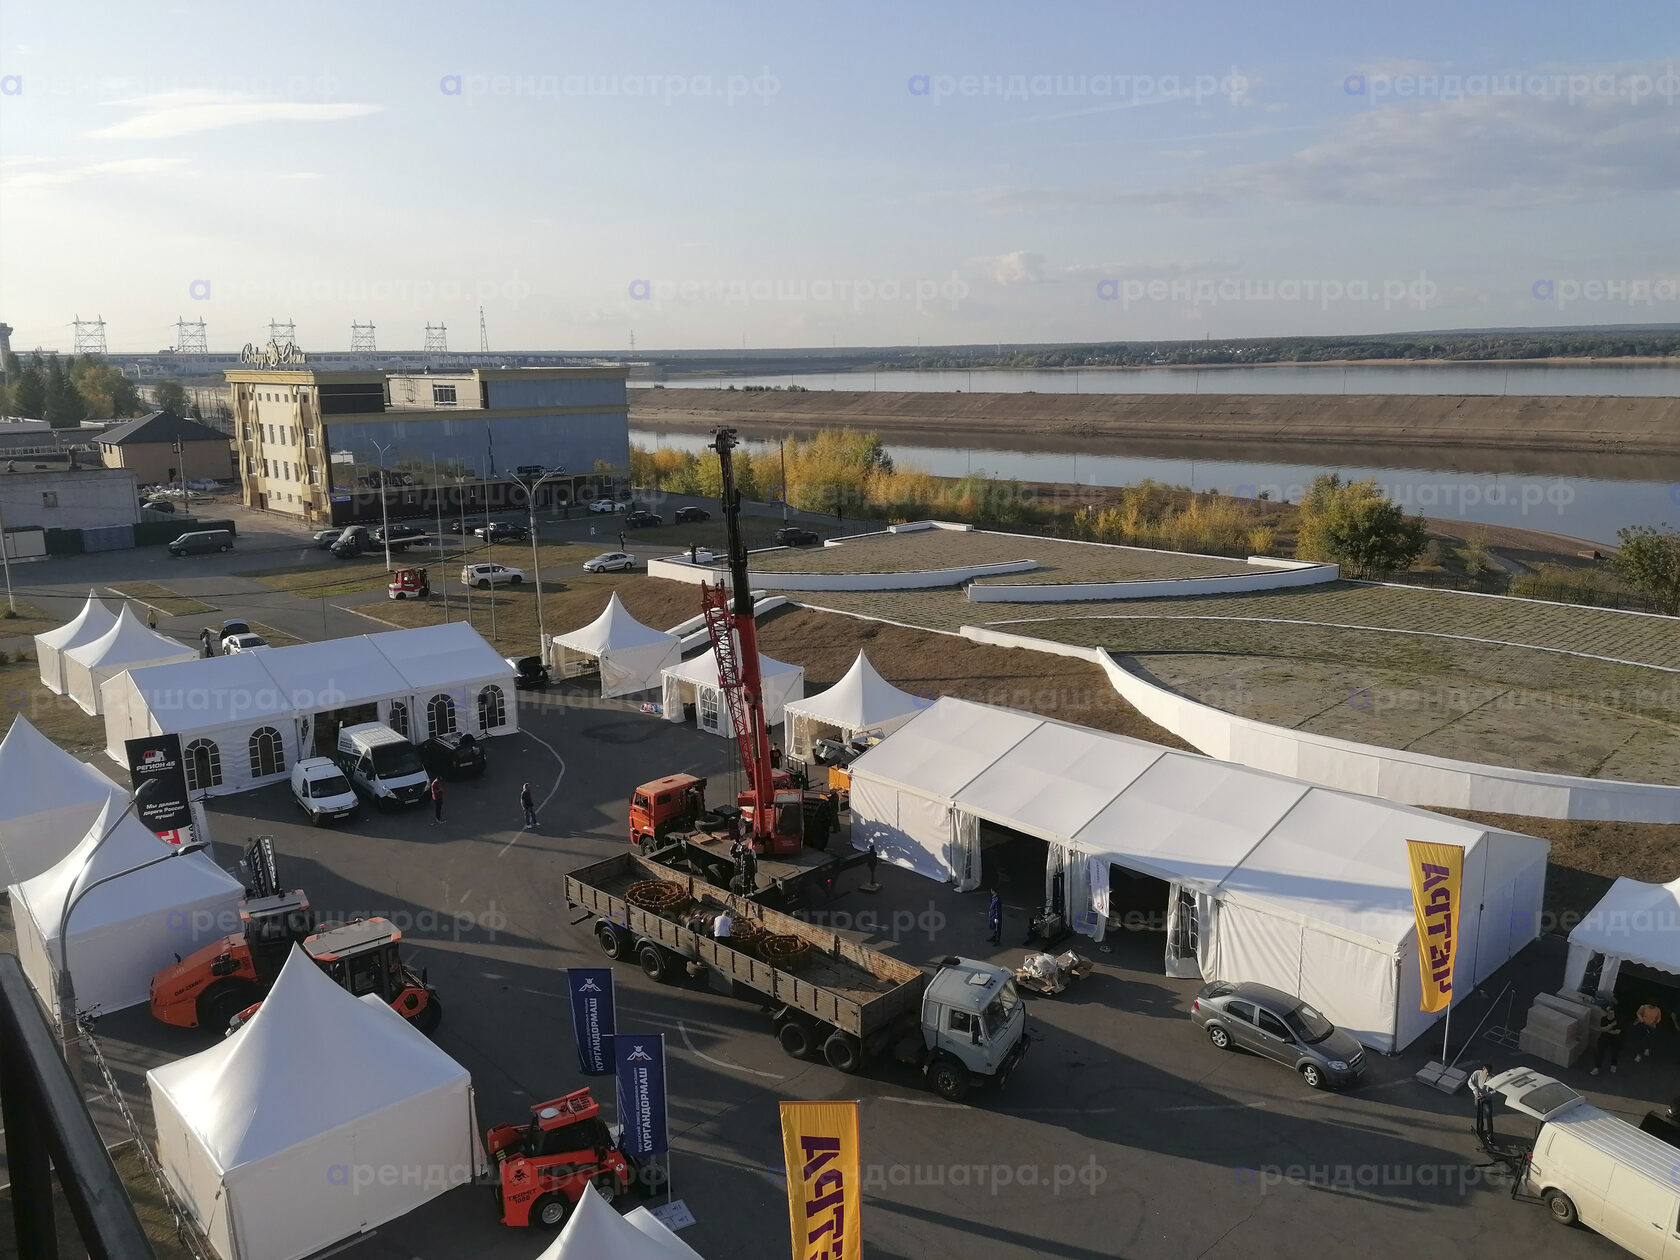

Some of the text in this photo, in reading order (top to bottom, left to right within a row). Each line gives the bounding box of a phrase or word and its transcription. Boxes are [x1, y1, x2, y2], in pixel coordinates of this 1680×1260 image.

[136, 762, 165, 771] РЕГИОН
[164, 805, 184, 813] России
[589, 997, 604, 1072] КУРГАНДОРМАШ
[638, 1067, 653, 1152] КУРГАНДОРМАШ
